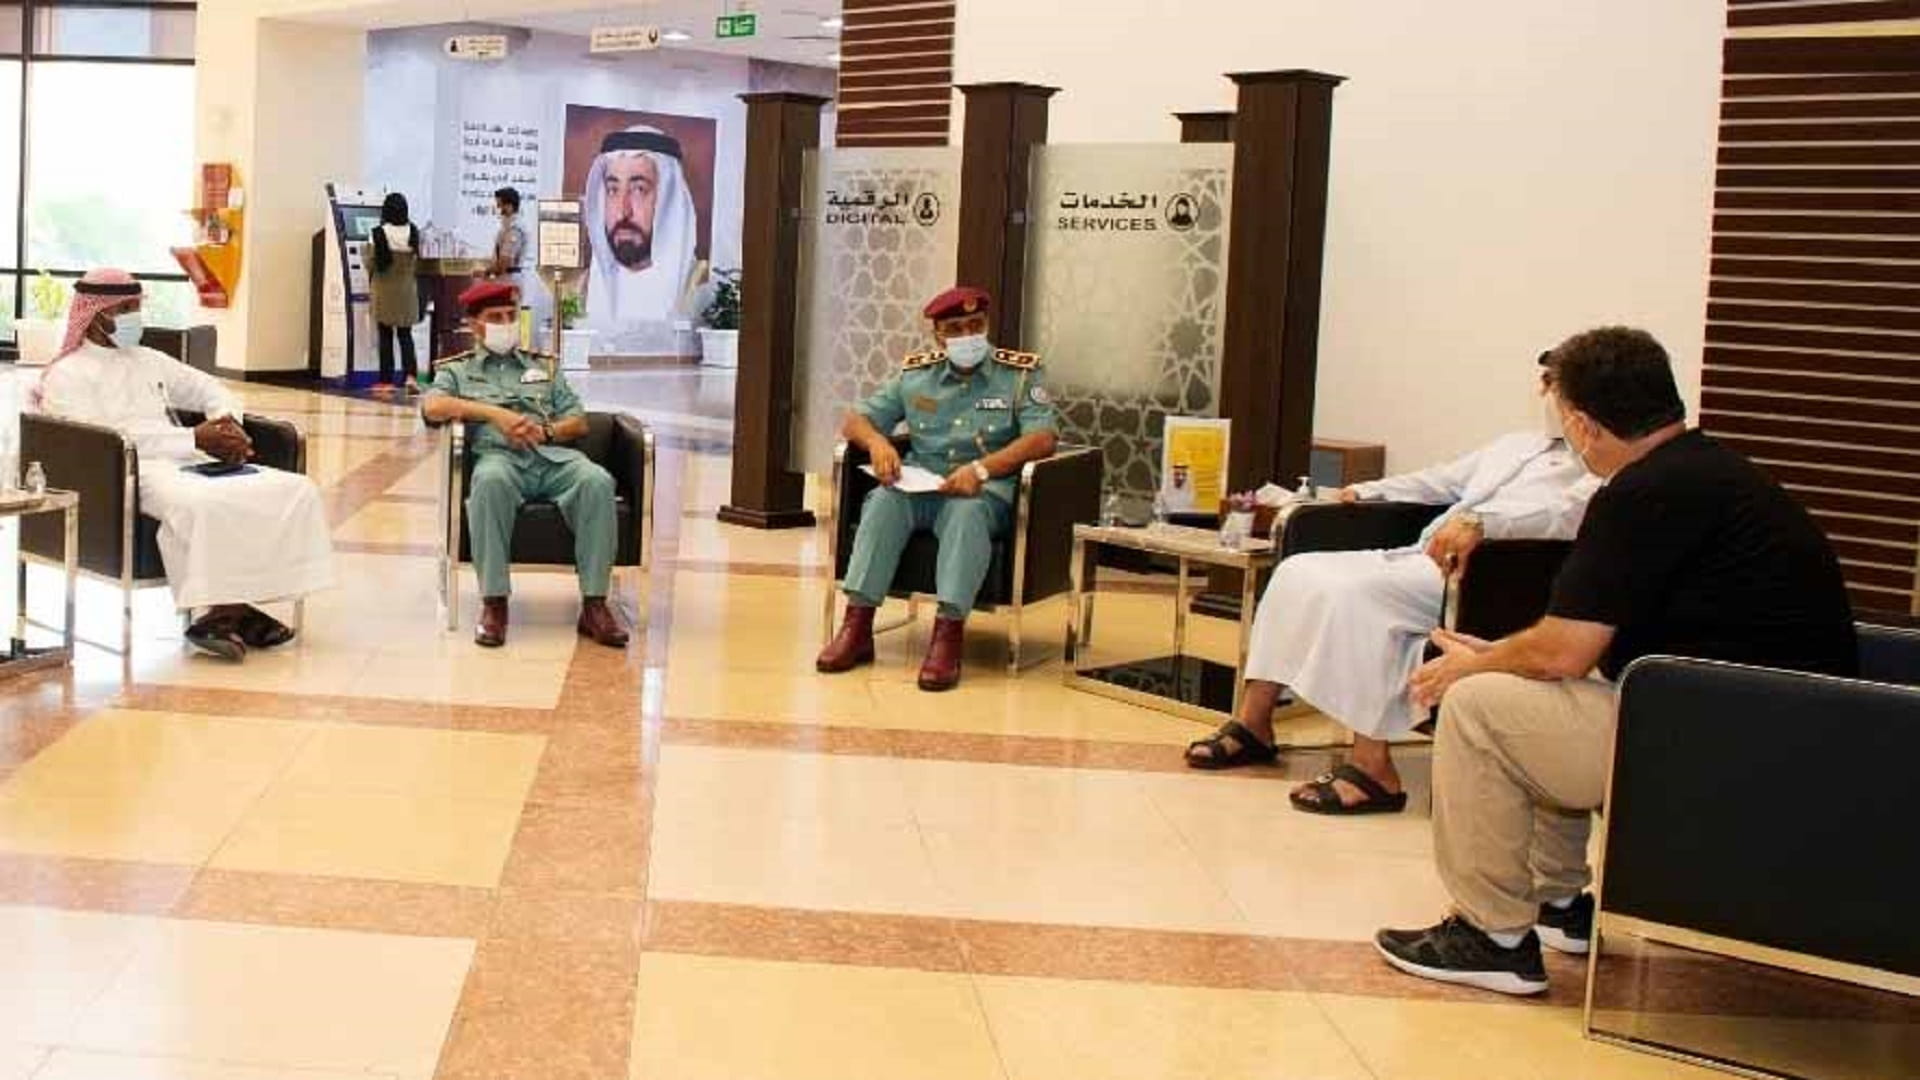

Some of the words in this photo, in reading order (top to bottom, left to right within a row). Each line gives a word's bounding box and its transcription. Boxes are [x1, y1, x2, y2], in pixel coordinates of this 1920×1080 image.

[826, 190, 908, 210] الرقمية
[1060, 192, 1157, 208] الخدمات
[826, 213, 905, 224] DIGITAL
[1058, 217, 1157, 231] SERVICES
